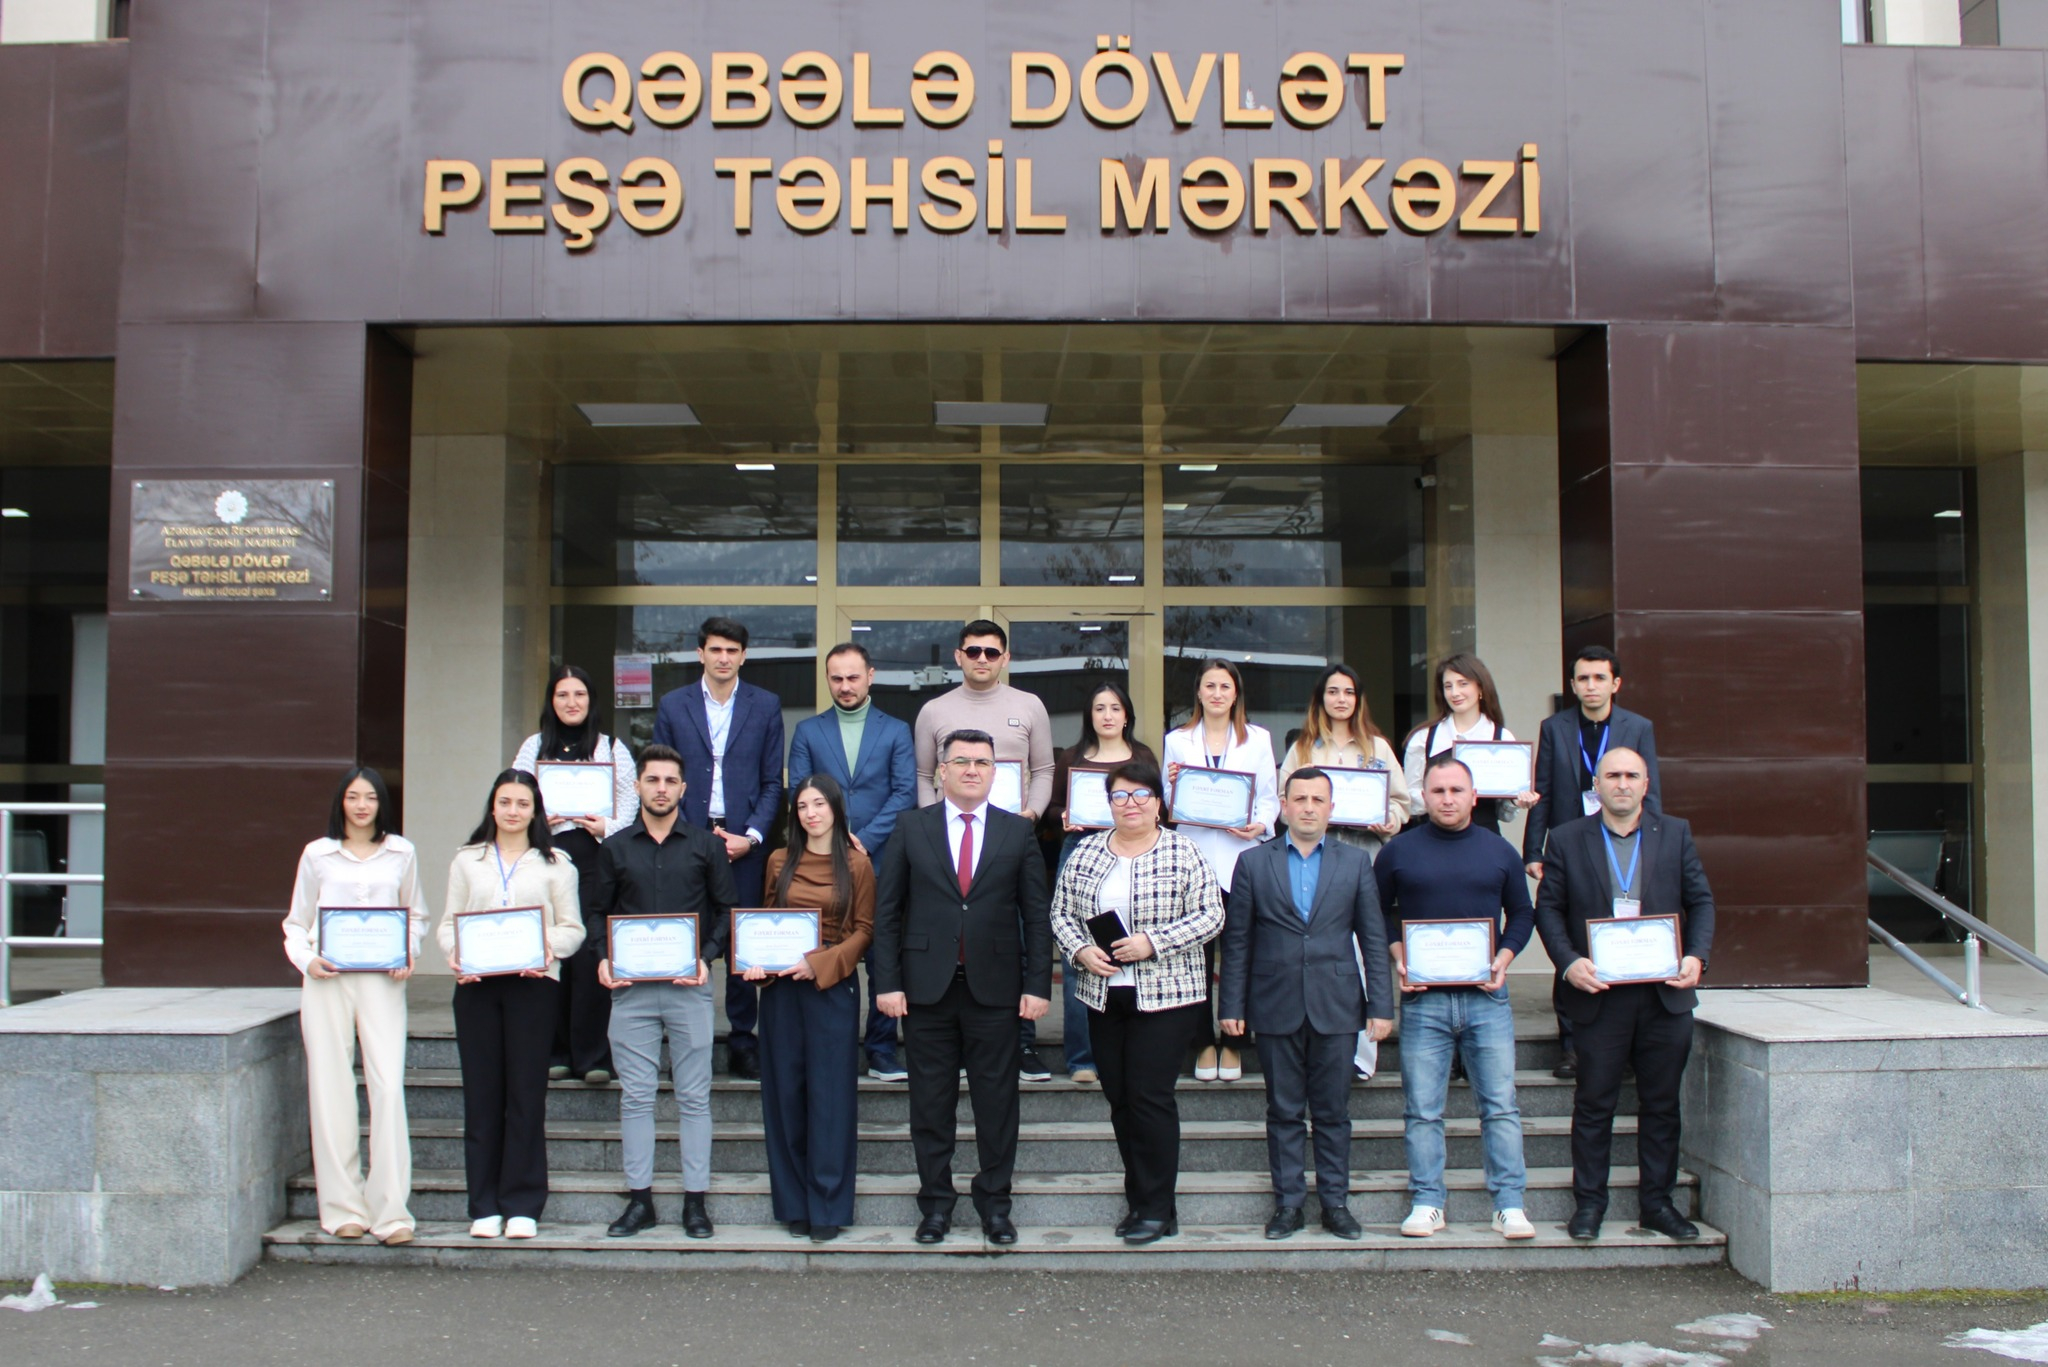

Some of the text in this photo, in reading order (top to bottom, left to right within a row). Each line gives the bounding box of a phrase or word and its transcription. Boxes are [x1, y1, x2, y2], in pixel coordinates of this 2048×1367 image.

[562, 35, 1405, 132] QƏBƏLƏ DÖVLƏT
[423, 139, 1541, 250] PEŞƏ TƏHSİL MƏRKƏZİ
[151, 568, 310, 587] PEŞƏ TƏHSİL MƏRKƏZİ
[169, 553, 291, 568] QƏBƏLƏ DÖVLƏT
